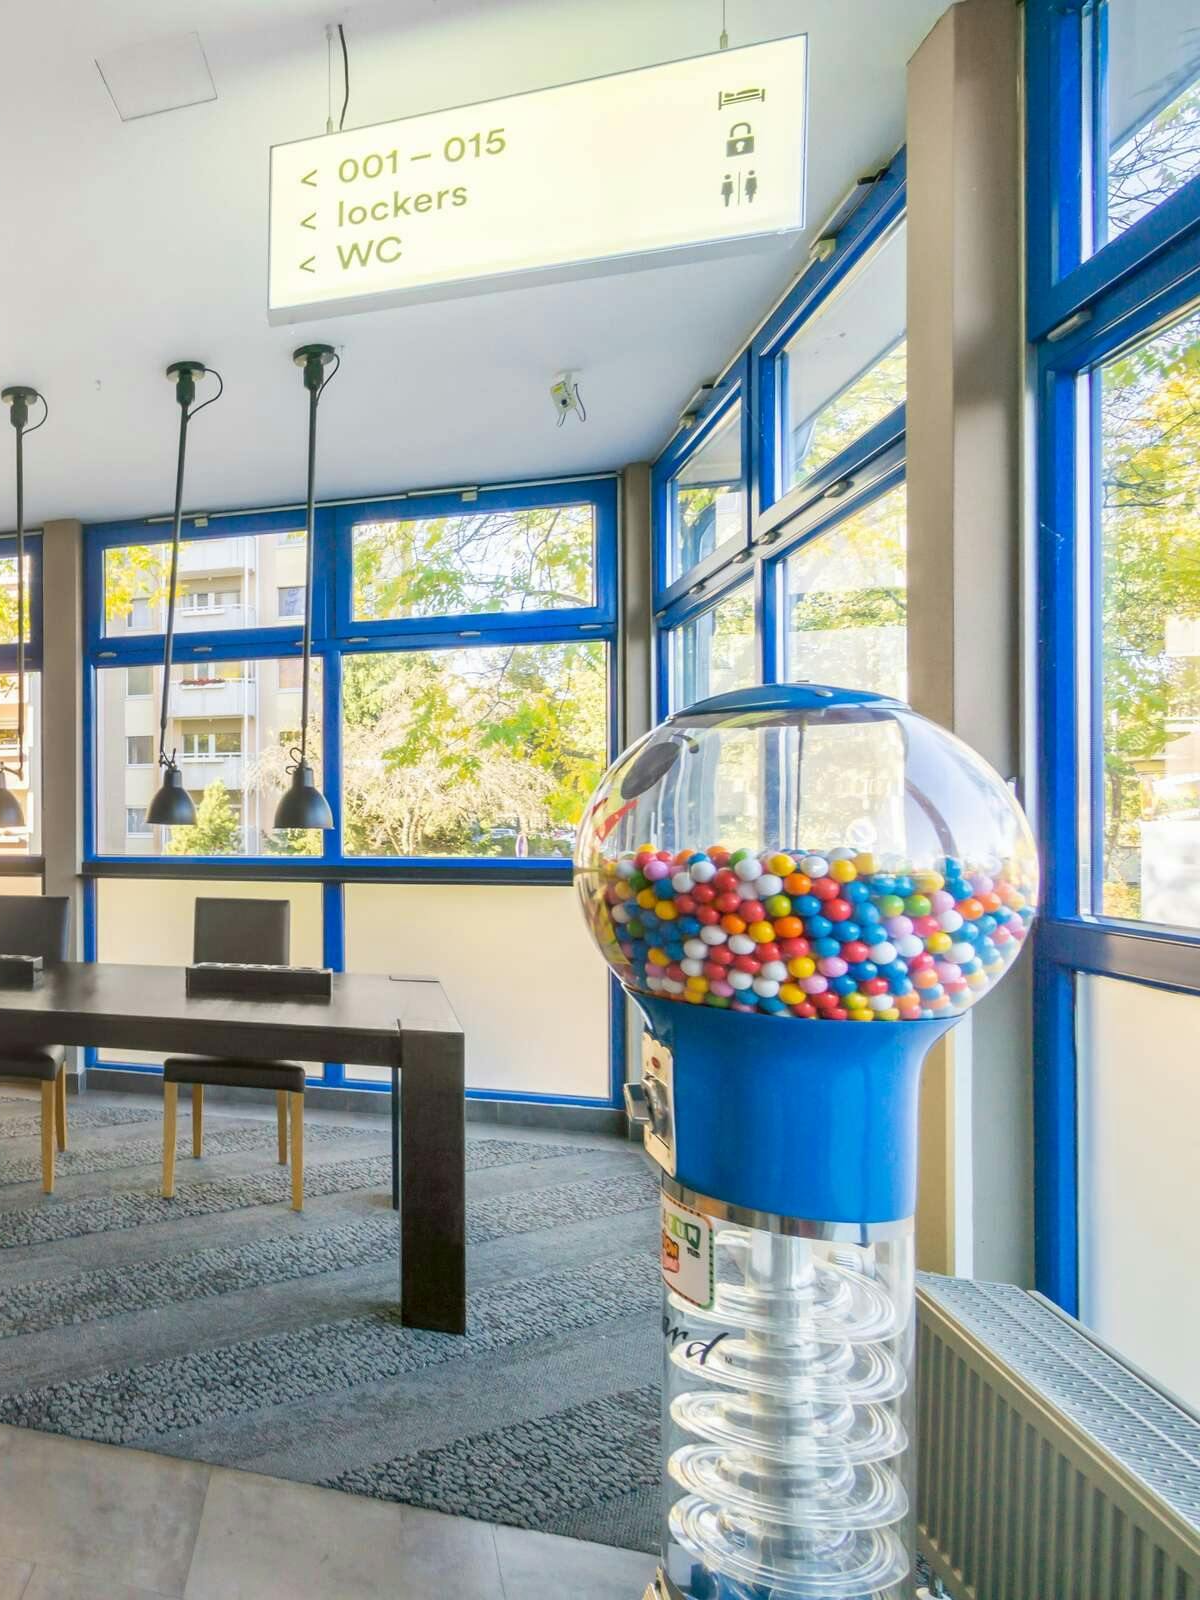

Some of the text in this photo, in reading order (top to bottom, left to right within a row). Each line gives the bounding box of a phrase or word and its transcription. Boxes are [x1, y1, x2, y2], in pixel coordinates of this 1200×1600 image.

[338, 149, 398, 183] 001
[443, 127, 507, 163] 015
[337, 186, 468, 227] lockers
[336, 236, 403, 270] WC
